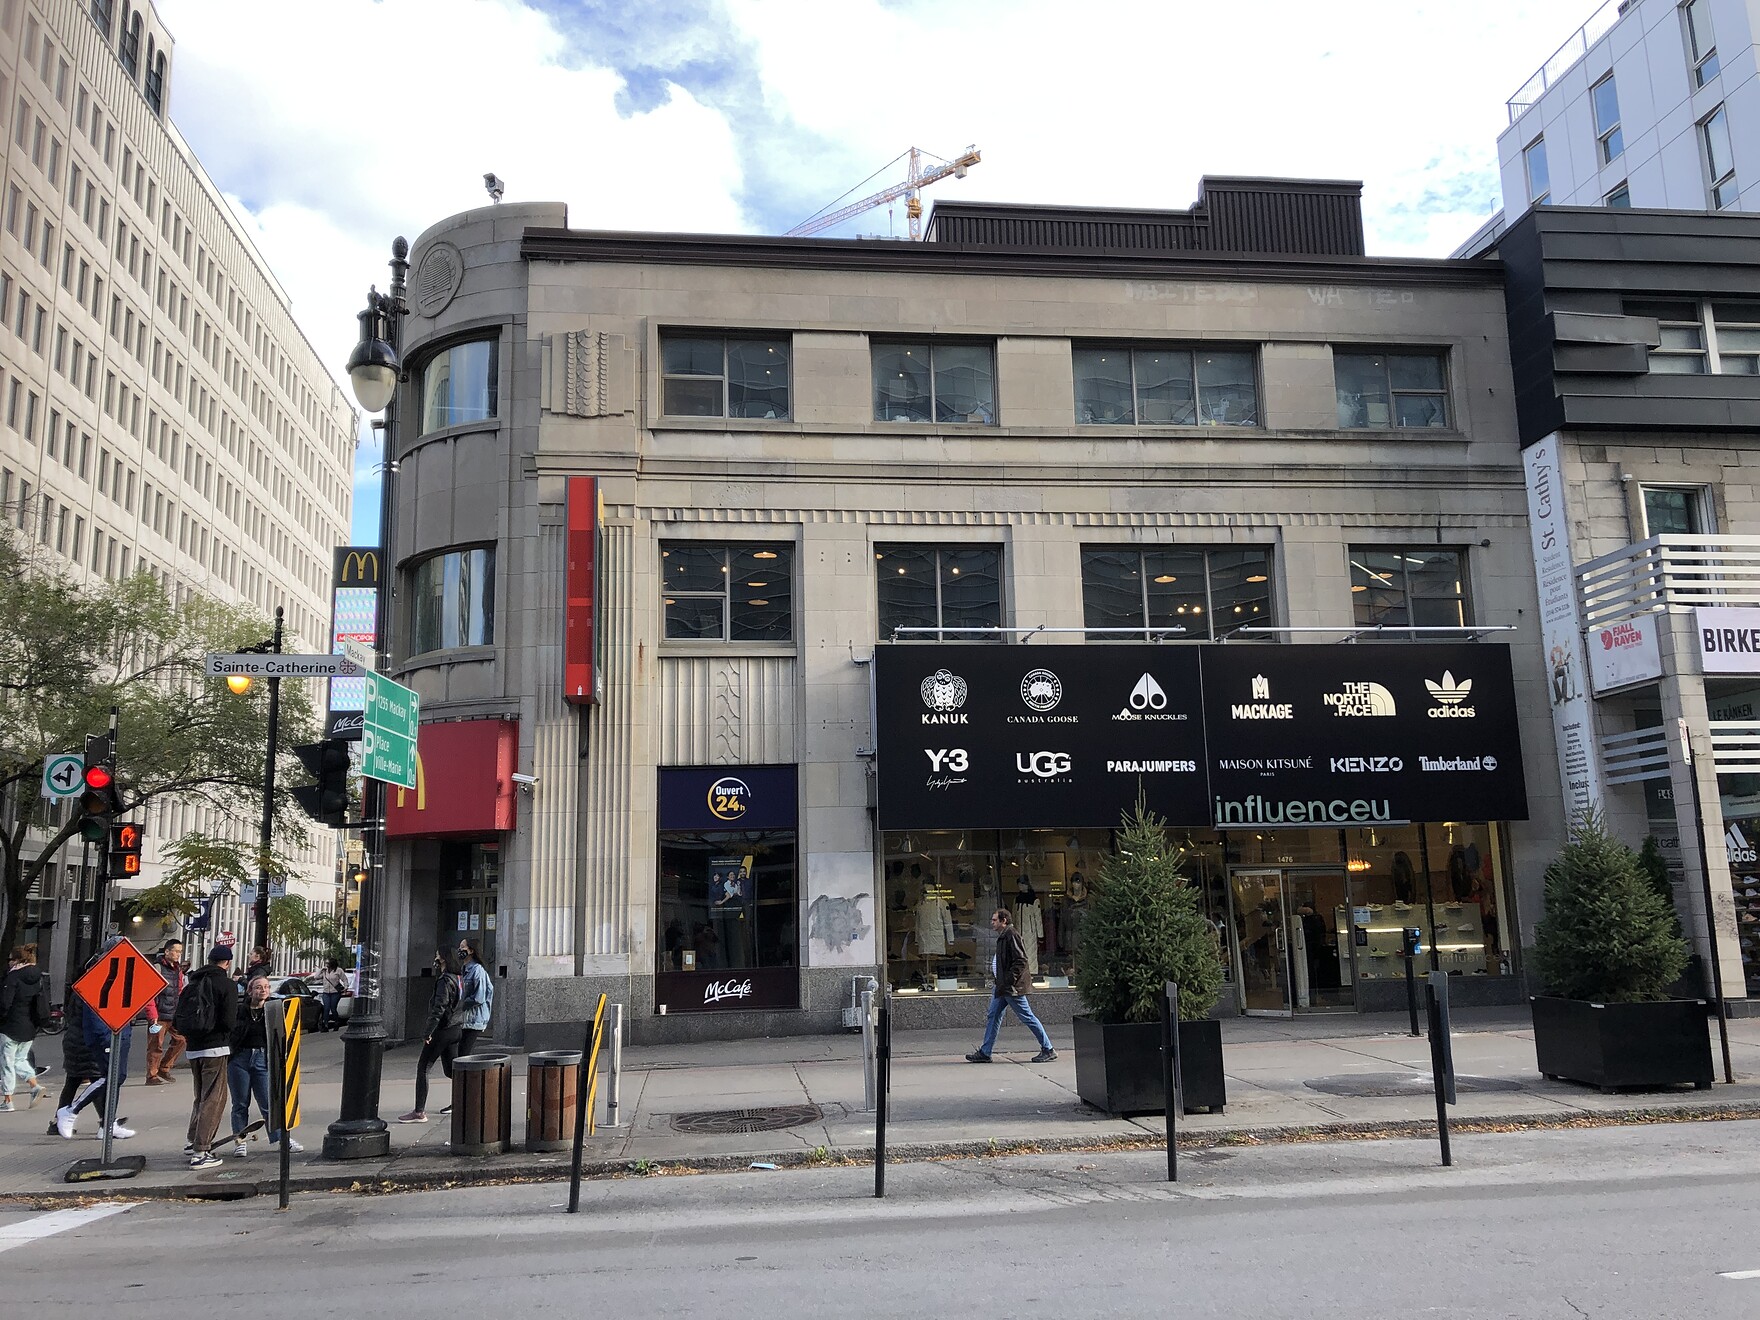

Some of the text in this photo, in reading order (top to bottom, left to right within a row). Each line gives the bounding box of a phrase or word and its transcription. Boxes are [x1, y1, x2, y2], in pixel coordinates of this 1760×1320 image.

[1532, 448, 1552, 520] Cathy's
[1613, 630, 1643, 648] RAVEN
[212, 661, 336, 674] Sainte-Catherine
[365, 676, 376, 714] P
[1342, 681, 1370, 693] THE
[1323, 693, 1370, 705] NORTH
[389, 699, 407, 722] Mackay
[921, 713, 969, 724] KANUK
[1007, 715, 1079, 723] CANADA GOOSE
[1111, 711, 1188, 721] MOOSE KNUCKLES
[1231, 703, 1294, 720] MACKAGE
[1427, 705, 1475, 718] adidas
[362, 729, 374, 767] P
[376, 735, 390, 752] Place
[375, 755, 402, 776] Ville-Marie
[924, 748, 969, 772] Y-3
[1016, 751, 1072, 778] UGG
[1106, 760, 1197, 773] PARAJUMPERS
[1219, 755, 1314, 769] MAISON KITSUNÉ
[1330, 756, 1403, 773] KENZO
[1418, 755, 1481, 772] Timberland
[715, 785, 744, 796] Ouvert
[1215, 794, 1391, 823] influenceu
[1277, 856, 1294, 864] 1476
